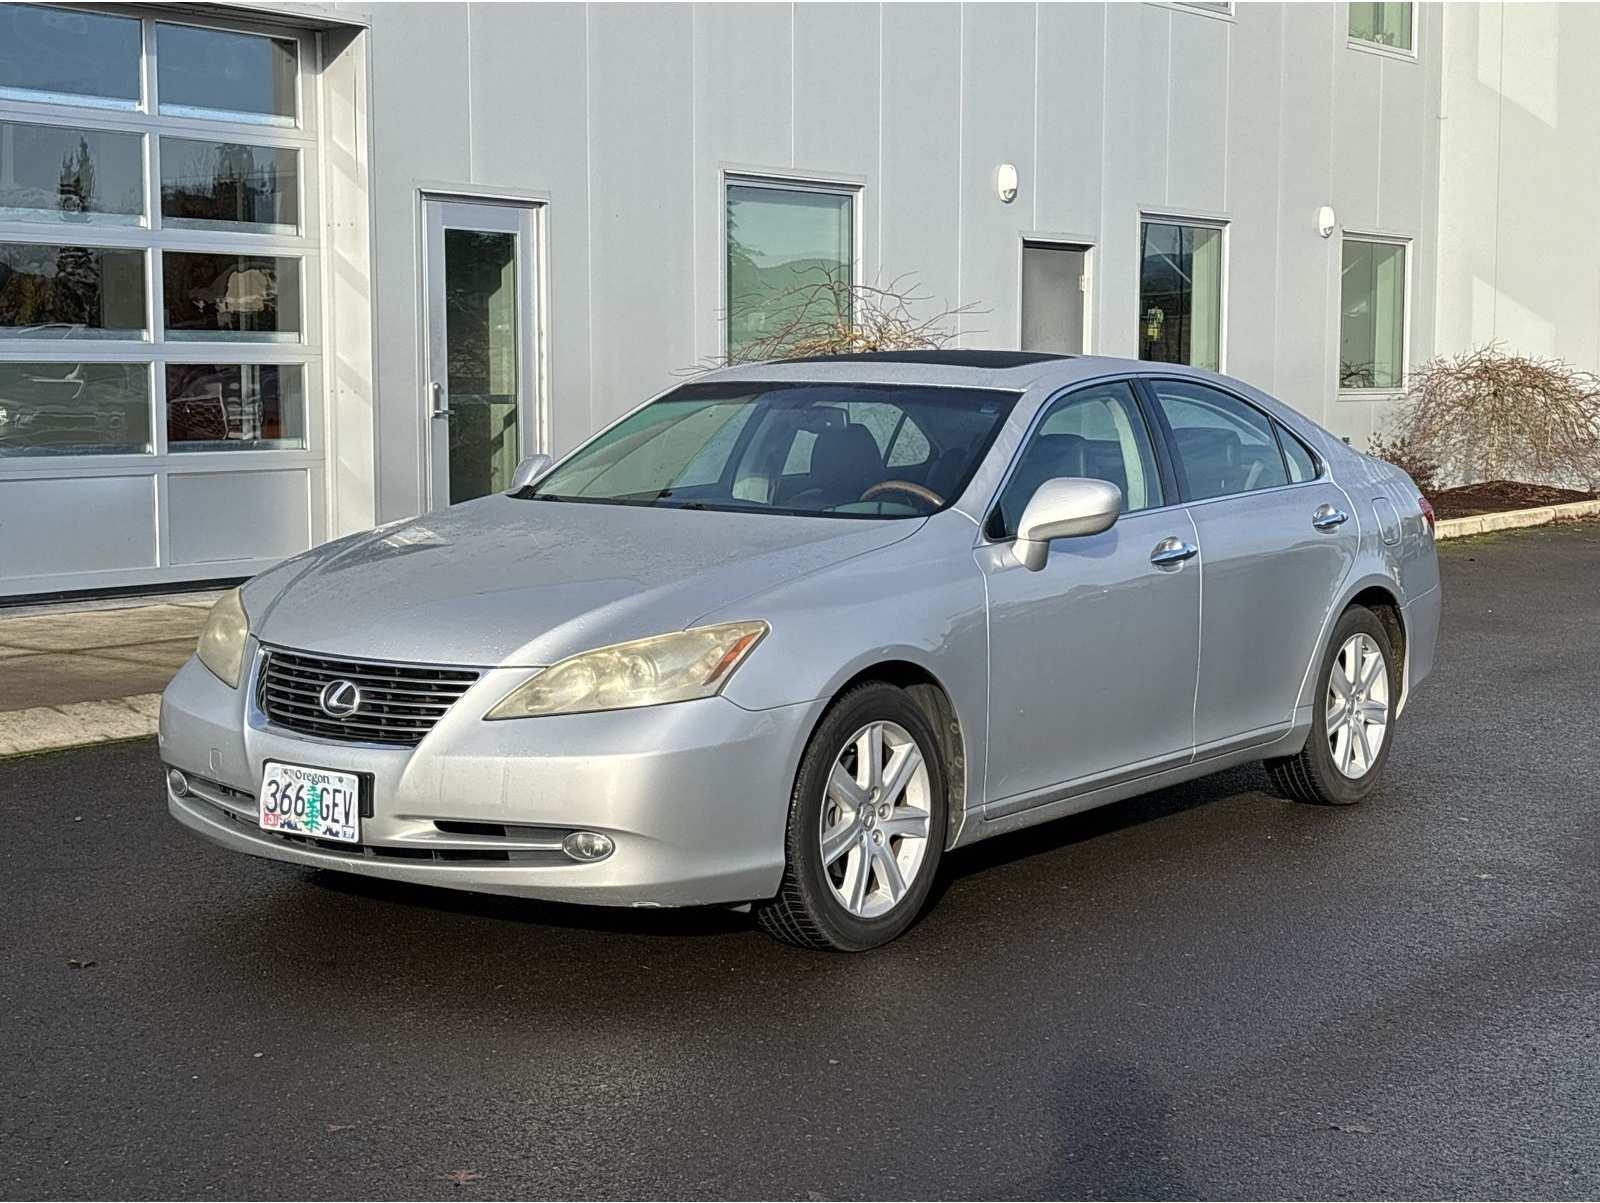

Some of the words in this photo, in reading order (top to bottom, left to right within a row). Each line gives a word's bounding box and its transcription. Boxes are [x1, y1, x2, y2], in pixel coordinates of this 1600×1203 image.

[295, 769, 330, 785] Oregon
[265, 779, 305, 816] 366
[320, 787, 352, 825] GEV
